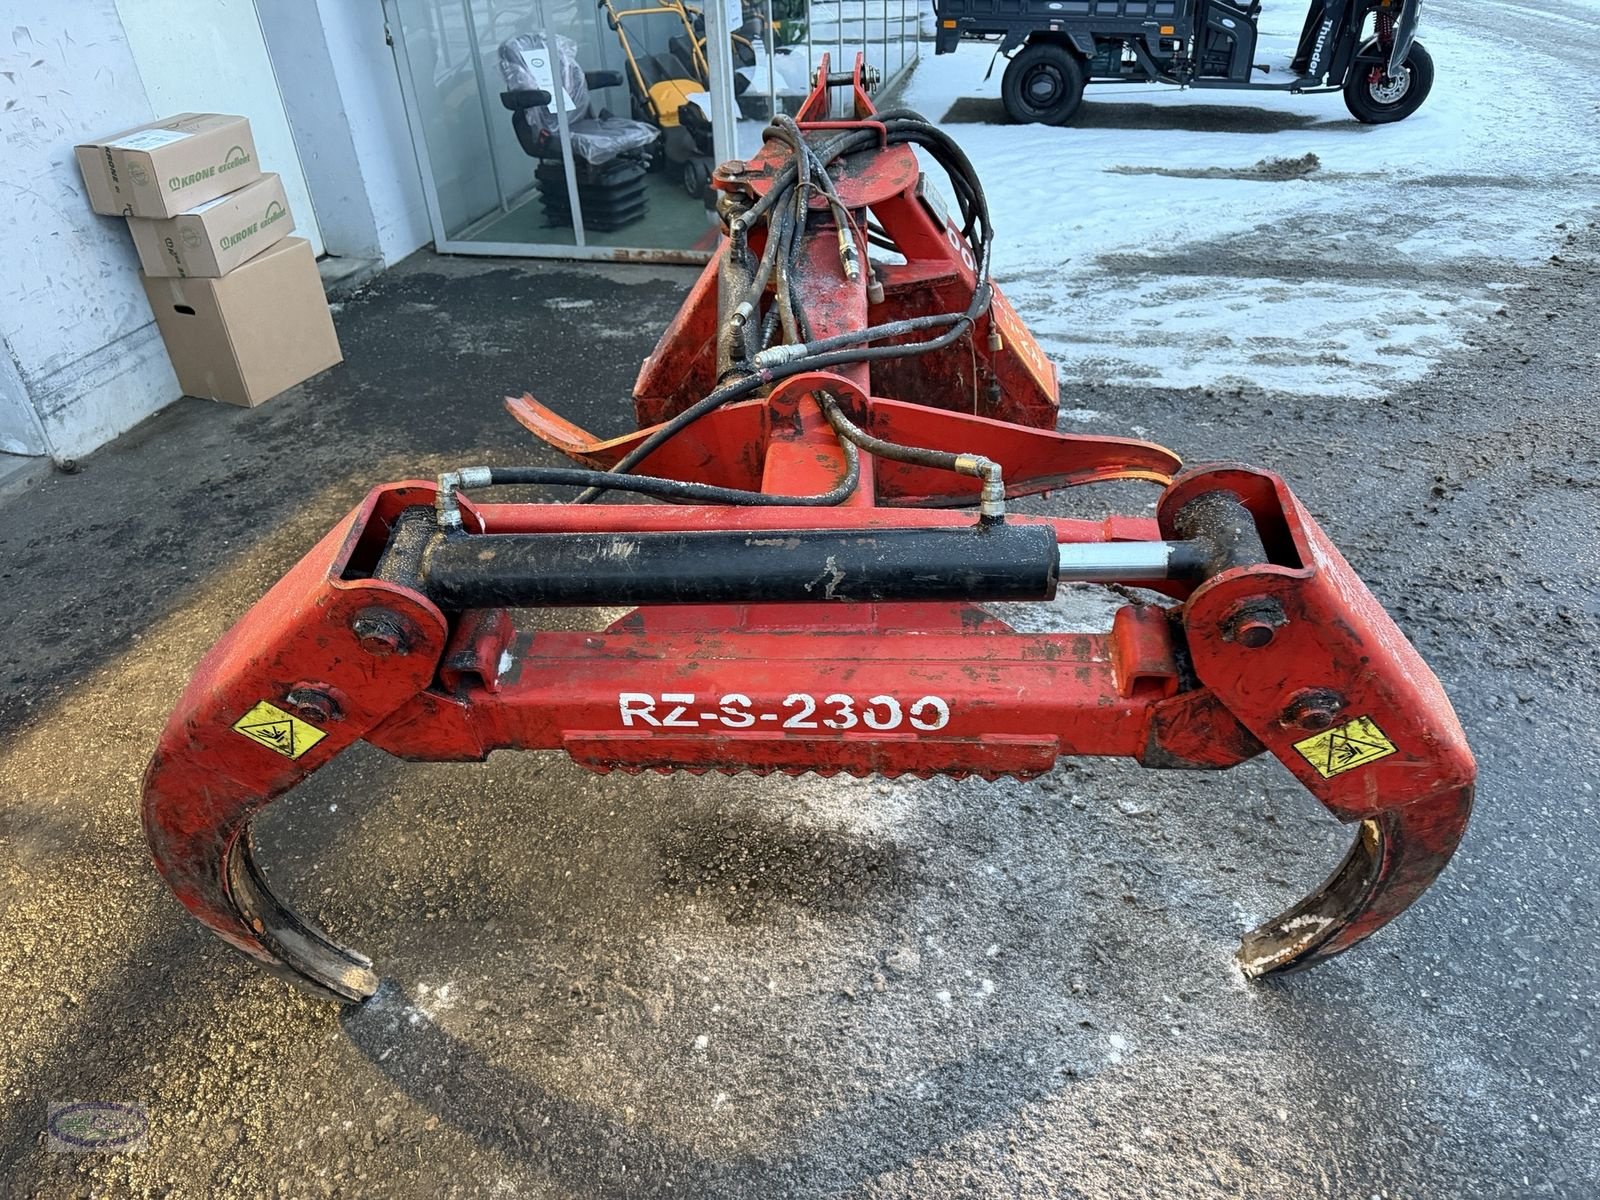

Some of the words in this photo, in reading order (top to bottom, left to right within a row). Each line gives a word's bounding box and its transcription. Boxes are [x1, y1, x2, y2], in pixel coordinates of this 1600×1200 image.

[1309, 19, 1333, 76] Thunder
[181, 166, 215, 188] KRONE
[218, 153, 251, 173] excellent
[230, 222, 258, 247] KRONE
[618, 692, 950, 730] RZ-S-2300
